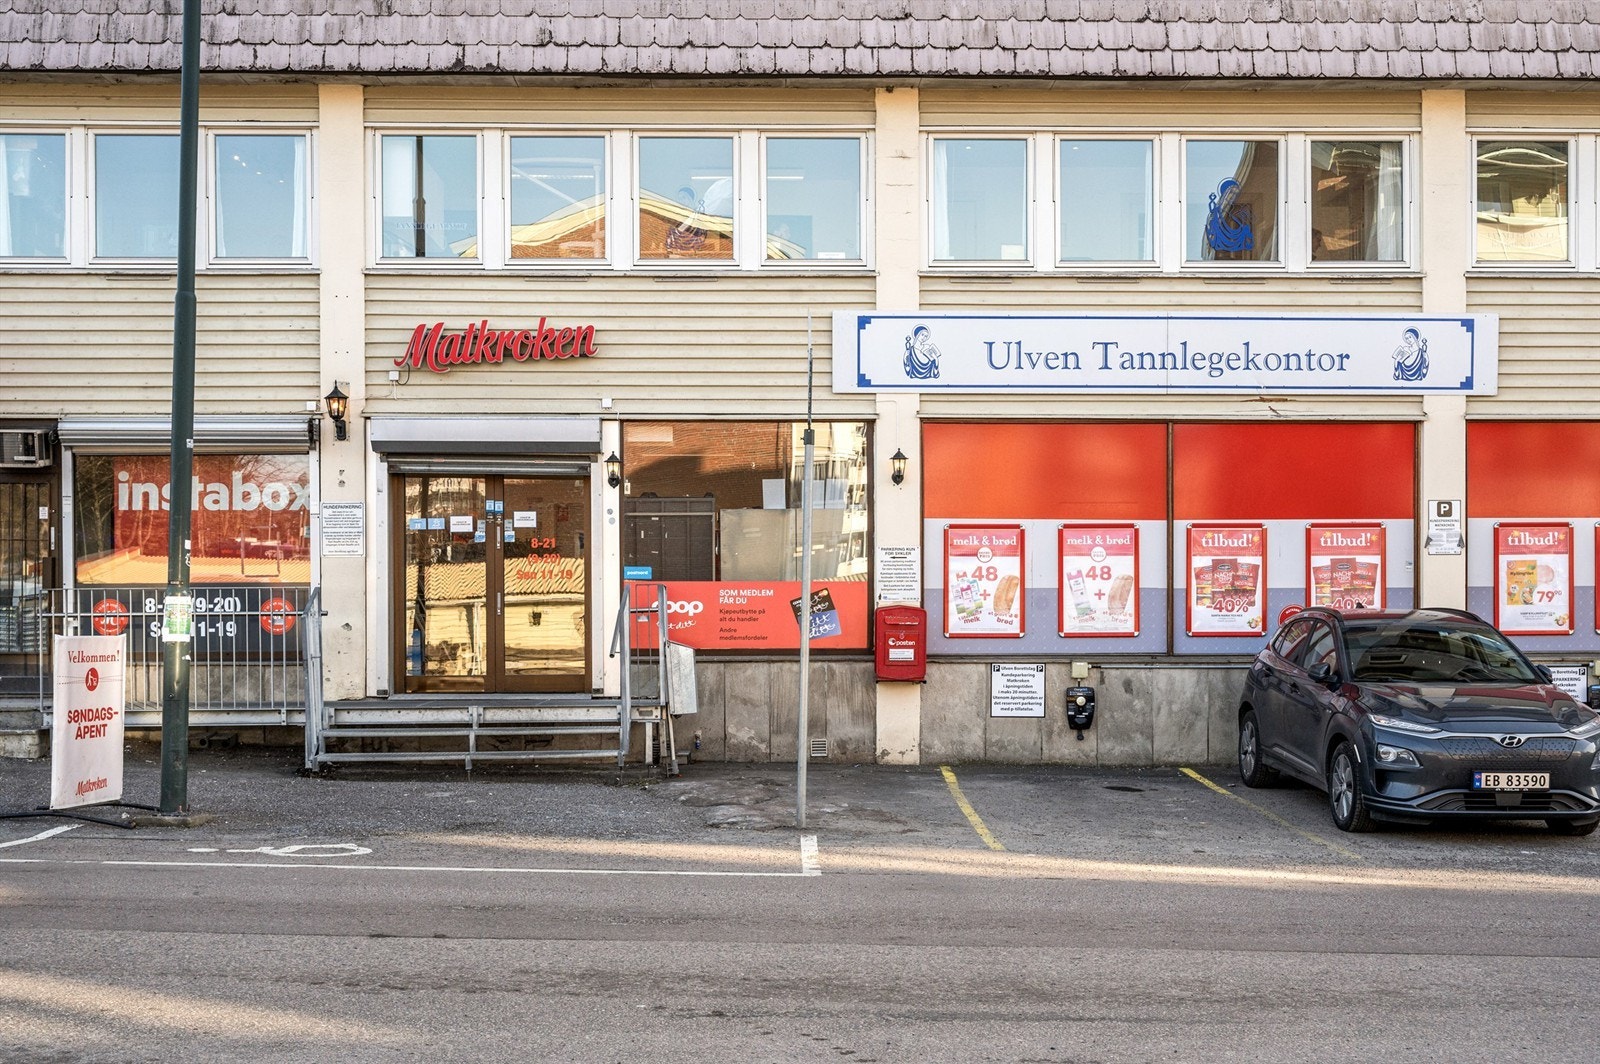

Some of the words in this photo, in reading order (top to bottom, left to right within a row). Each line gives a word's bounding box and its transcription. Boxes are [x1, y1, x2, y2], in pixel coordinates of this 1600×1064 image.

[394, 316, 599, 373] Matkroken
[984, 341, 1081, 371] Ulven
[1093, 340, 1350, 377] Tannlegekontor
[531, 537, 556, 548] 8-21
[953, 535, 979, 545] melk
[982, 536, 991, 545] &
[993, 535, 1017, 545] brød
[1067, 535, 1092, 545] melk
[1095, 535, 1104, 545] &
[1106, 535, 1131, 545] brød
[1201, 533, 1253, 547] tilbud!
[1320, 532, 1371, 547] tilbud!
[1508, 532, 1559, 546] tilbud!
[527, 553, 561, 566] (9-20)
[541, 569, 573, 579] 11-19
[971, 566, 998, 581] 48
[1085, 566, 1112, 581] 48
[719, 596, 734, 604] FÅR
[1206, 599, 1249, 613] -40%
[963, 616, 981, 624] melk
[996, 616, 1014, 626] brød
[68, 650, 120, 663] Velkommen!
[67, 707, 119, 724] SØNDAGS-
[75, 722, 107, 740] ÅPENT
[76, 776, 108, 796] Matkroken
[1485, 775, 1500, 786] EB
[1506, 775, 1546, 786] 83590
